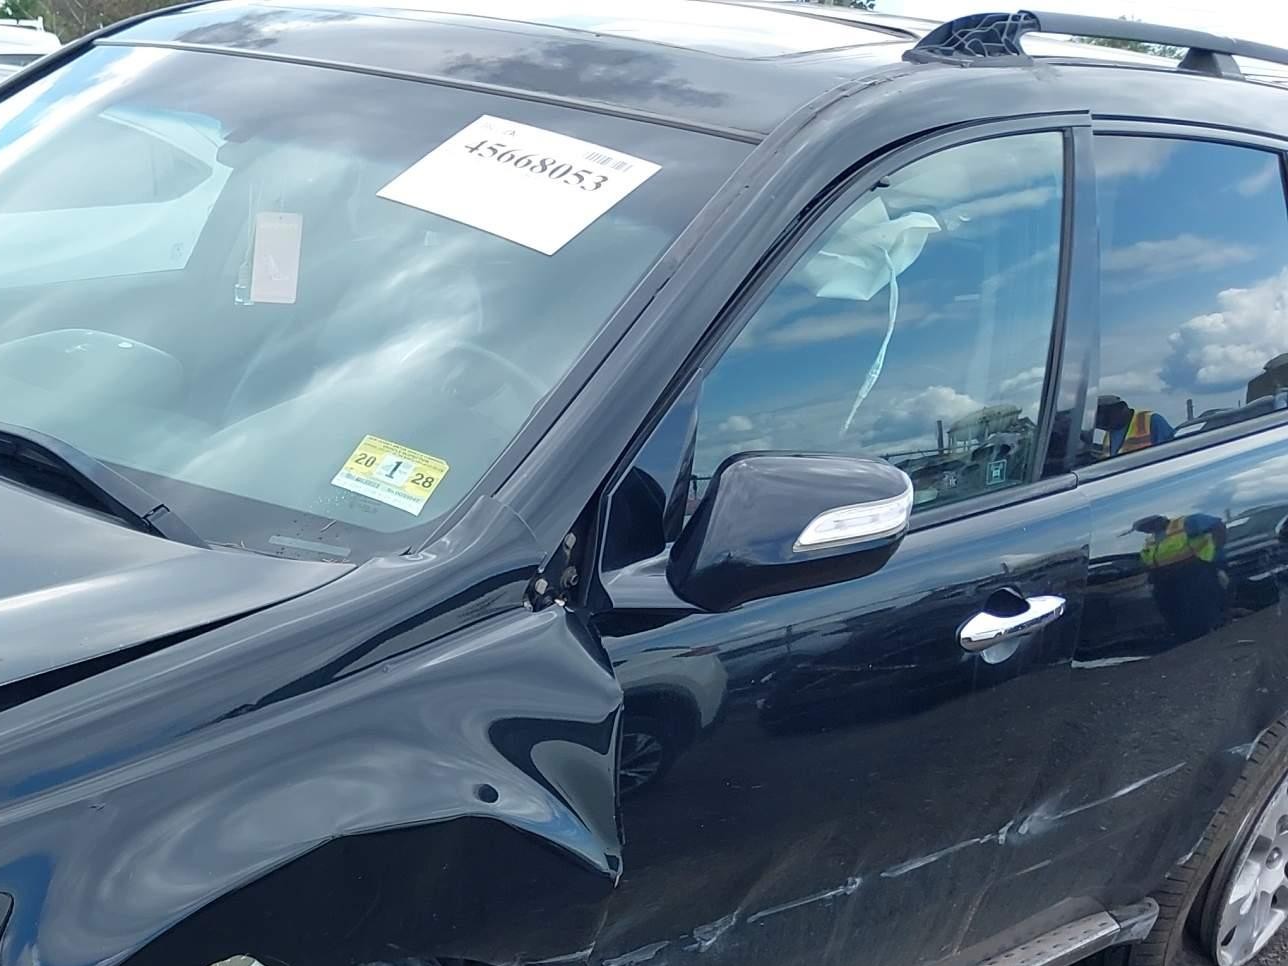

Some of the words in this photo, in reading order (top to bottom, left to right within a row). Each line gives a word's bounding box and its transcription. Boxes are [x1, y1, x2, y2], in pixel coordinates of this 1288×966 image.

[464, 139, 609, 192] 45668053
[354, 452, 377, 469] 20
[385, 460, 403, 480] 1
[410, 472, 434, 489] 28
